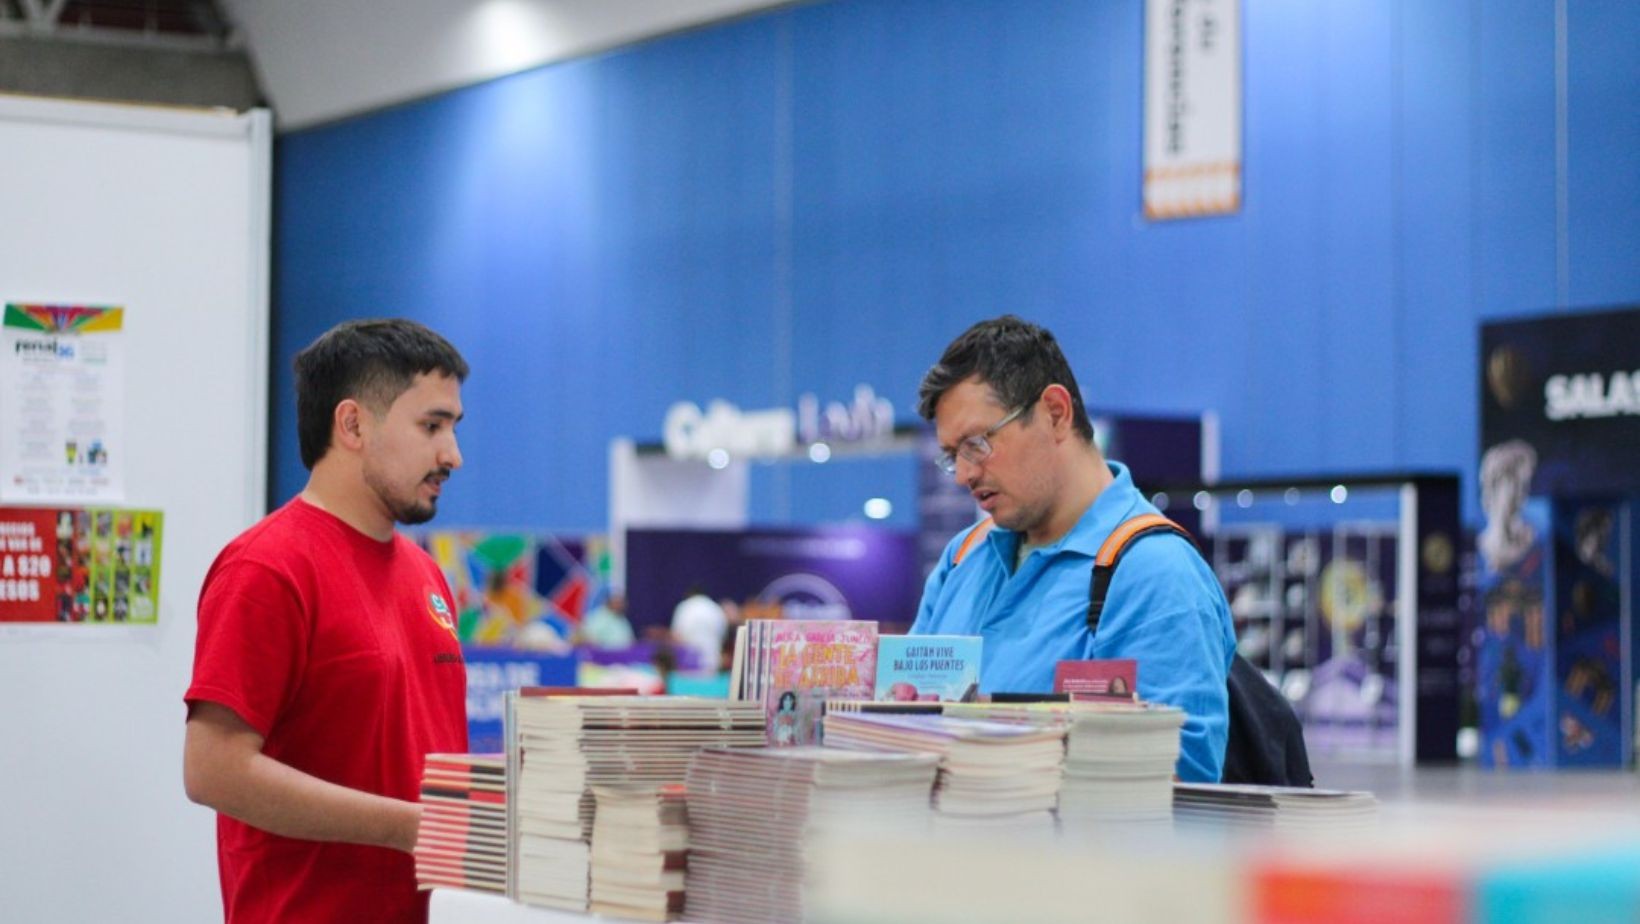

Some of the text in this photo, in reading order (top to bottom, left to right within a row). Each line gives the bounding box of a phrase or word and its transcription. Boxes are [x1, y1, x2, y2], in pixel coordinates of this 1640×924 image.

[936, 646, 955, 658] VIVE
[894, 660, 964, 672] BAJO LOS PUENTES
